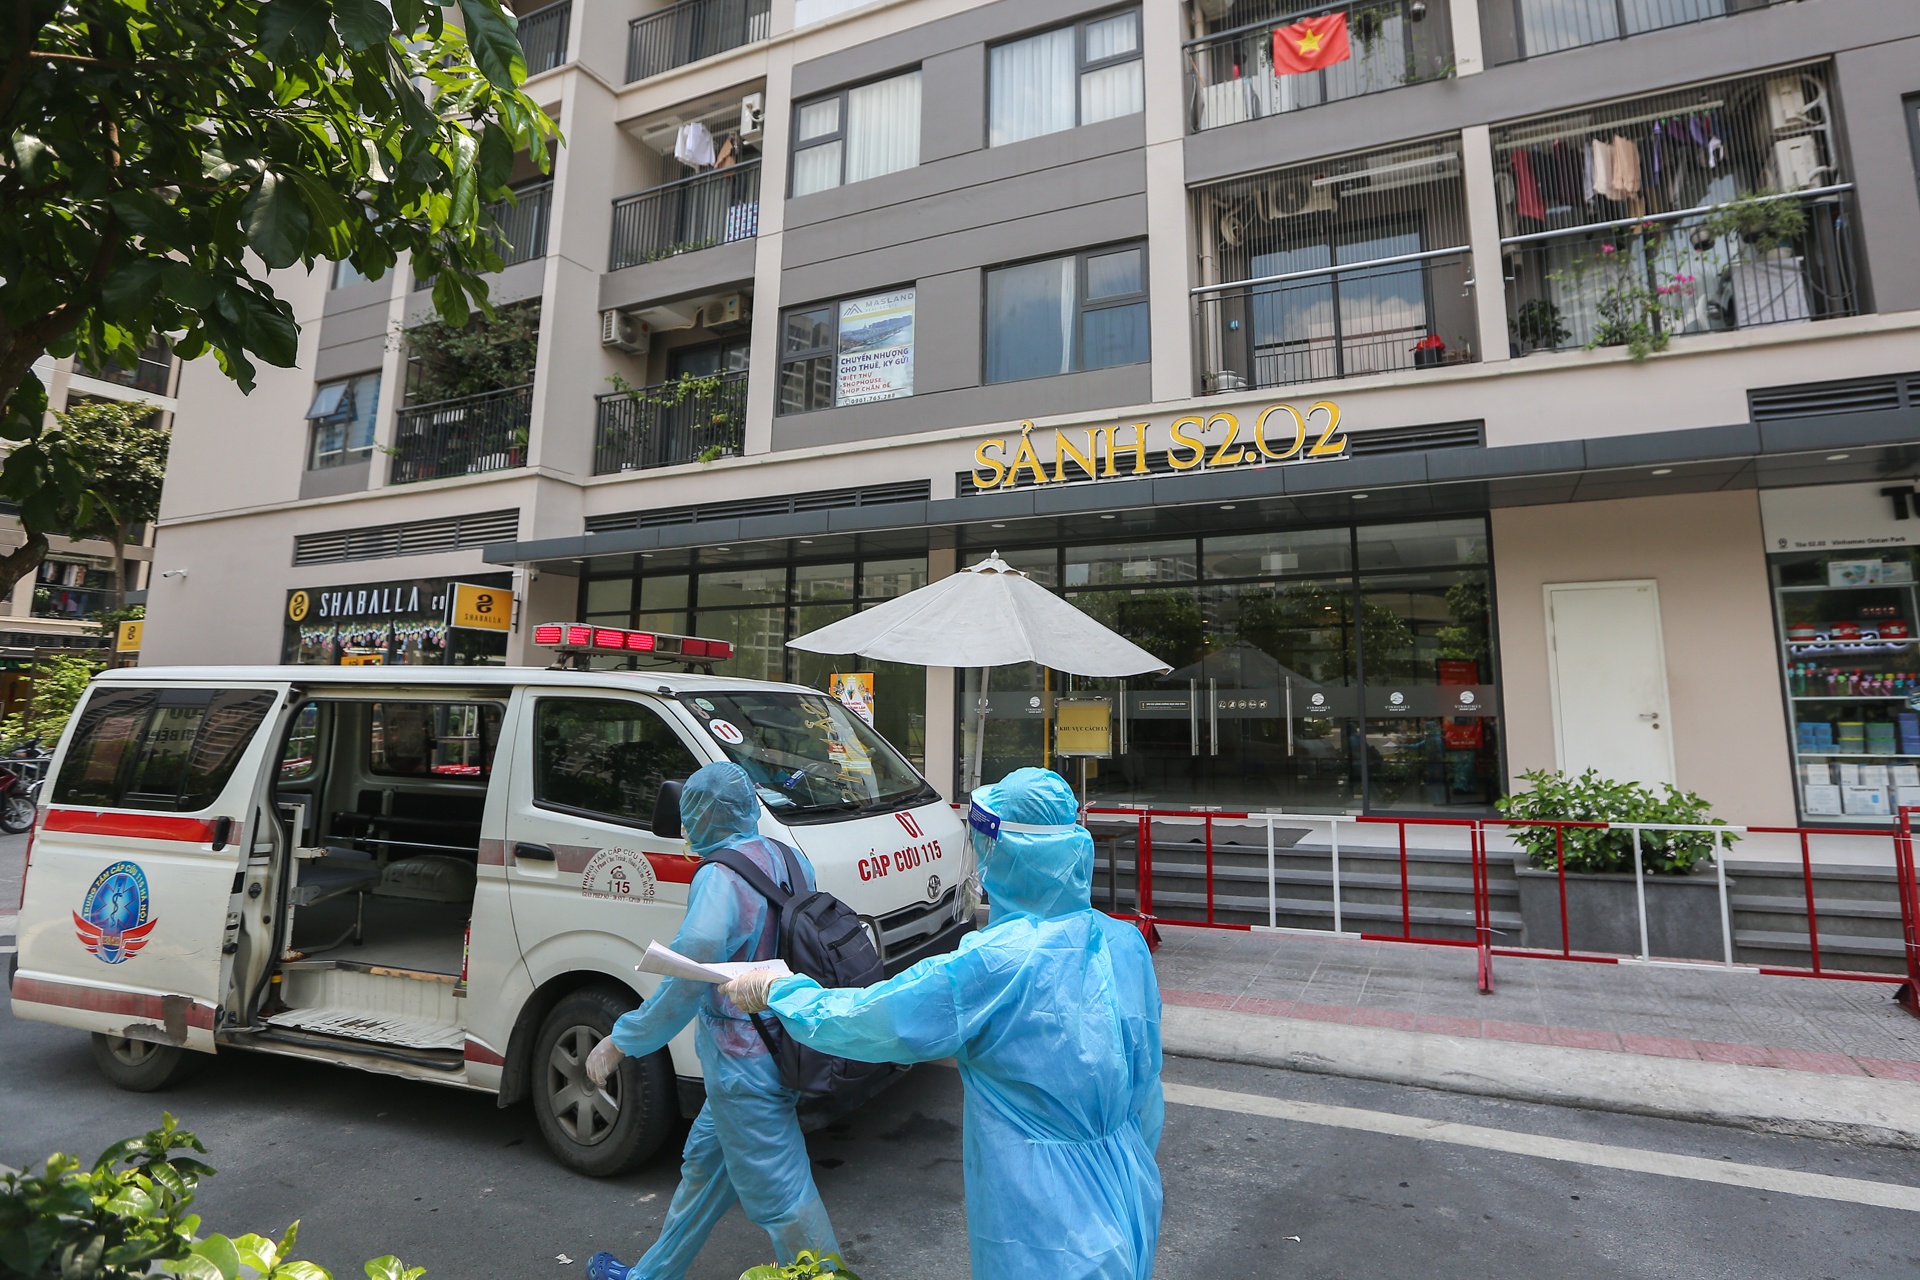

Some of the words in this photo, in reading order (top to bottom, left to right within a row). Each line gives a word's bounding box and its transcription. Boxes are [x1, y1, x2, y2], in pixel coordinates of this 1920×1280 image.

[865, 293, 914, 308] MASLAND
[840, 365, 857, 374] CHO
[842, 377, 882, 388] SHOPHOUSE
[842, 387, 860, 395] SHOP
[971, 418, 1151, 489] SẢNH
[319, 586, 419, 617] SHABALLA
[464, 613, 502, 624] SHABALLA
[713, 723, 739, 740] 11
[921, 840, 942, 863] 115
[582, 864, 595, 891] TRUNG
[593, 852, 607, 865] TÂM
[638, 859, 647, 870] 115
[83, 887, 96, 917] TRUNG
[95, 870, 110, 886] TÂM
[110, 862, 125, 875] CẤP
[607, 880, 630, 894] 115
